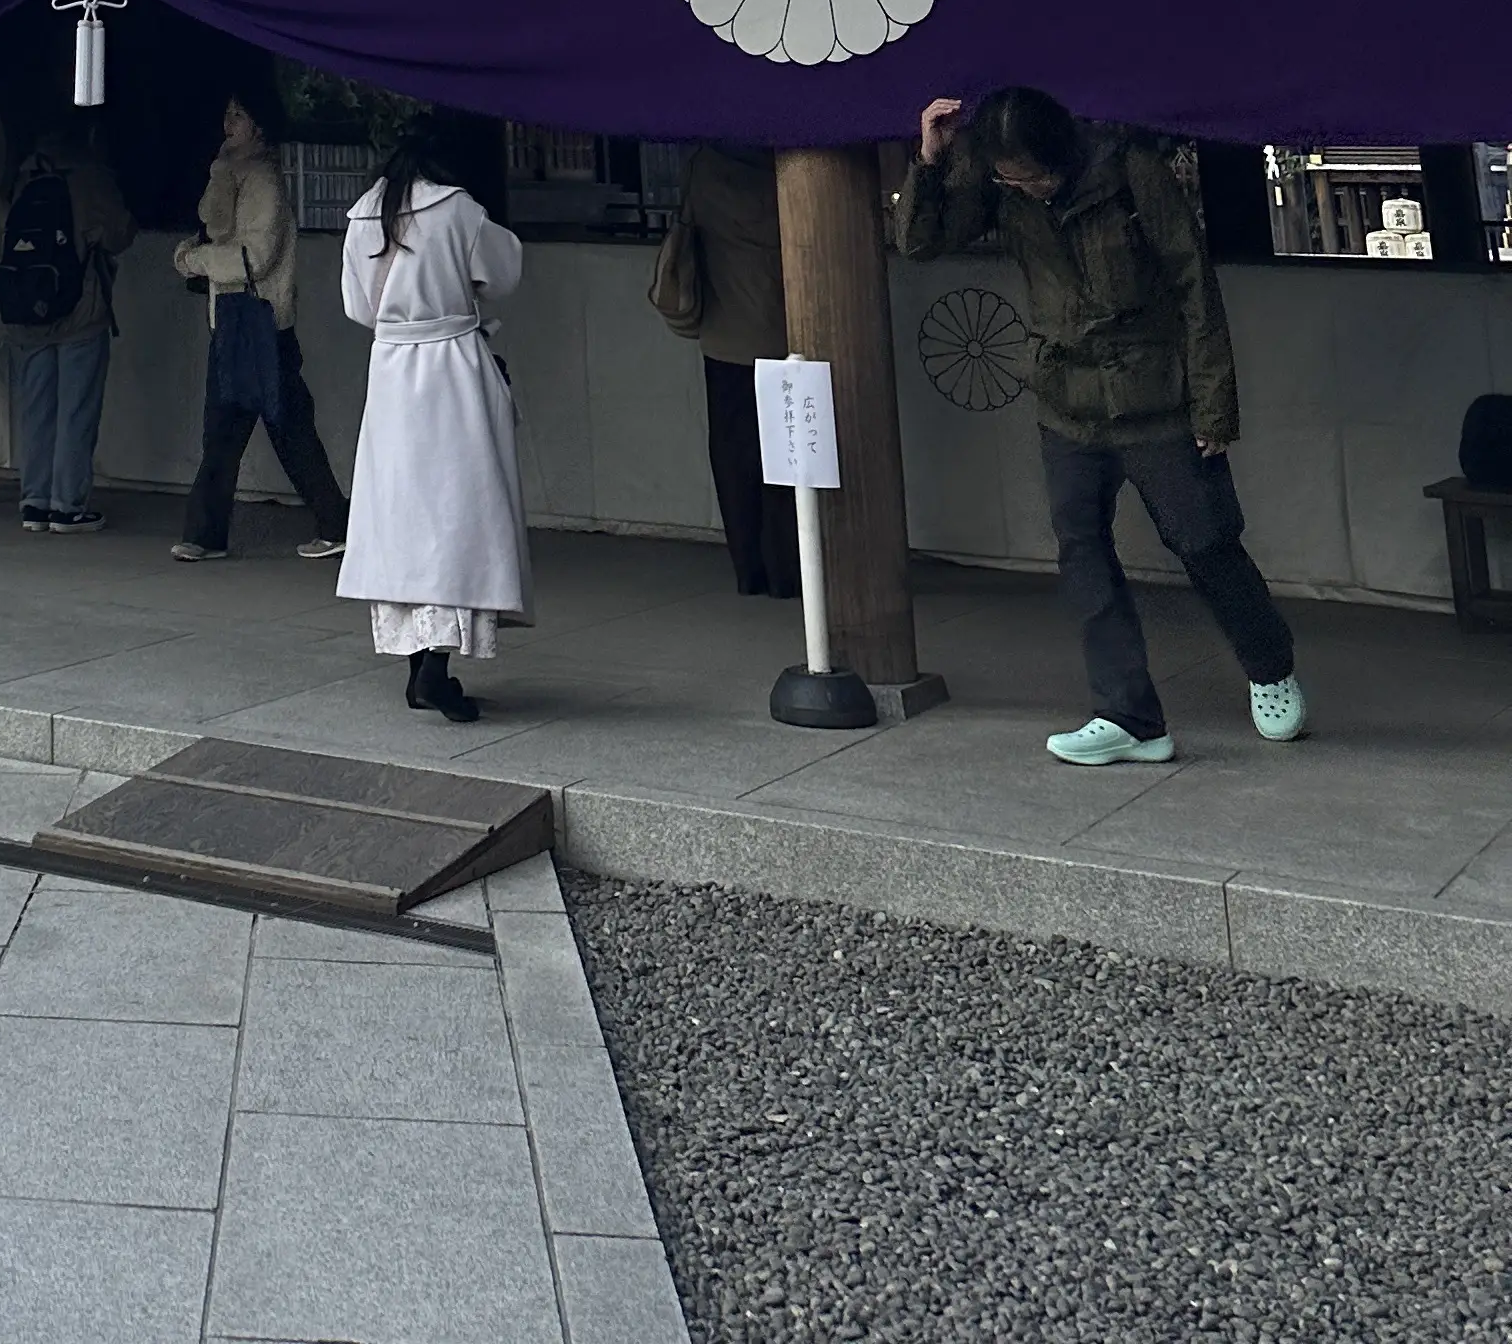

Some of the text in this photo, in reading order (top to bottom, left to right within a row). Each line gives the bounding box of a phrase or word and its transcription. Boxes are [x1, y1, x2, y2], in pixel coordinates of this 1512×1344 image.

[781, 379, 798, 466] 御参拝下さい
[803, 396, 817, 454] 広がって
